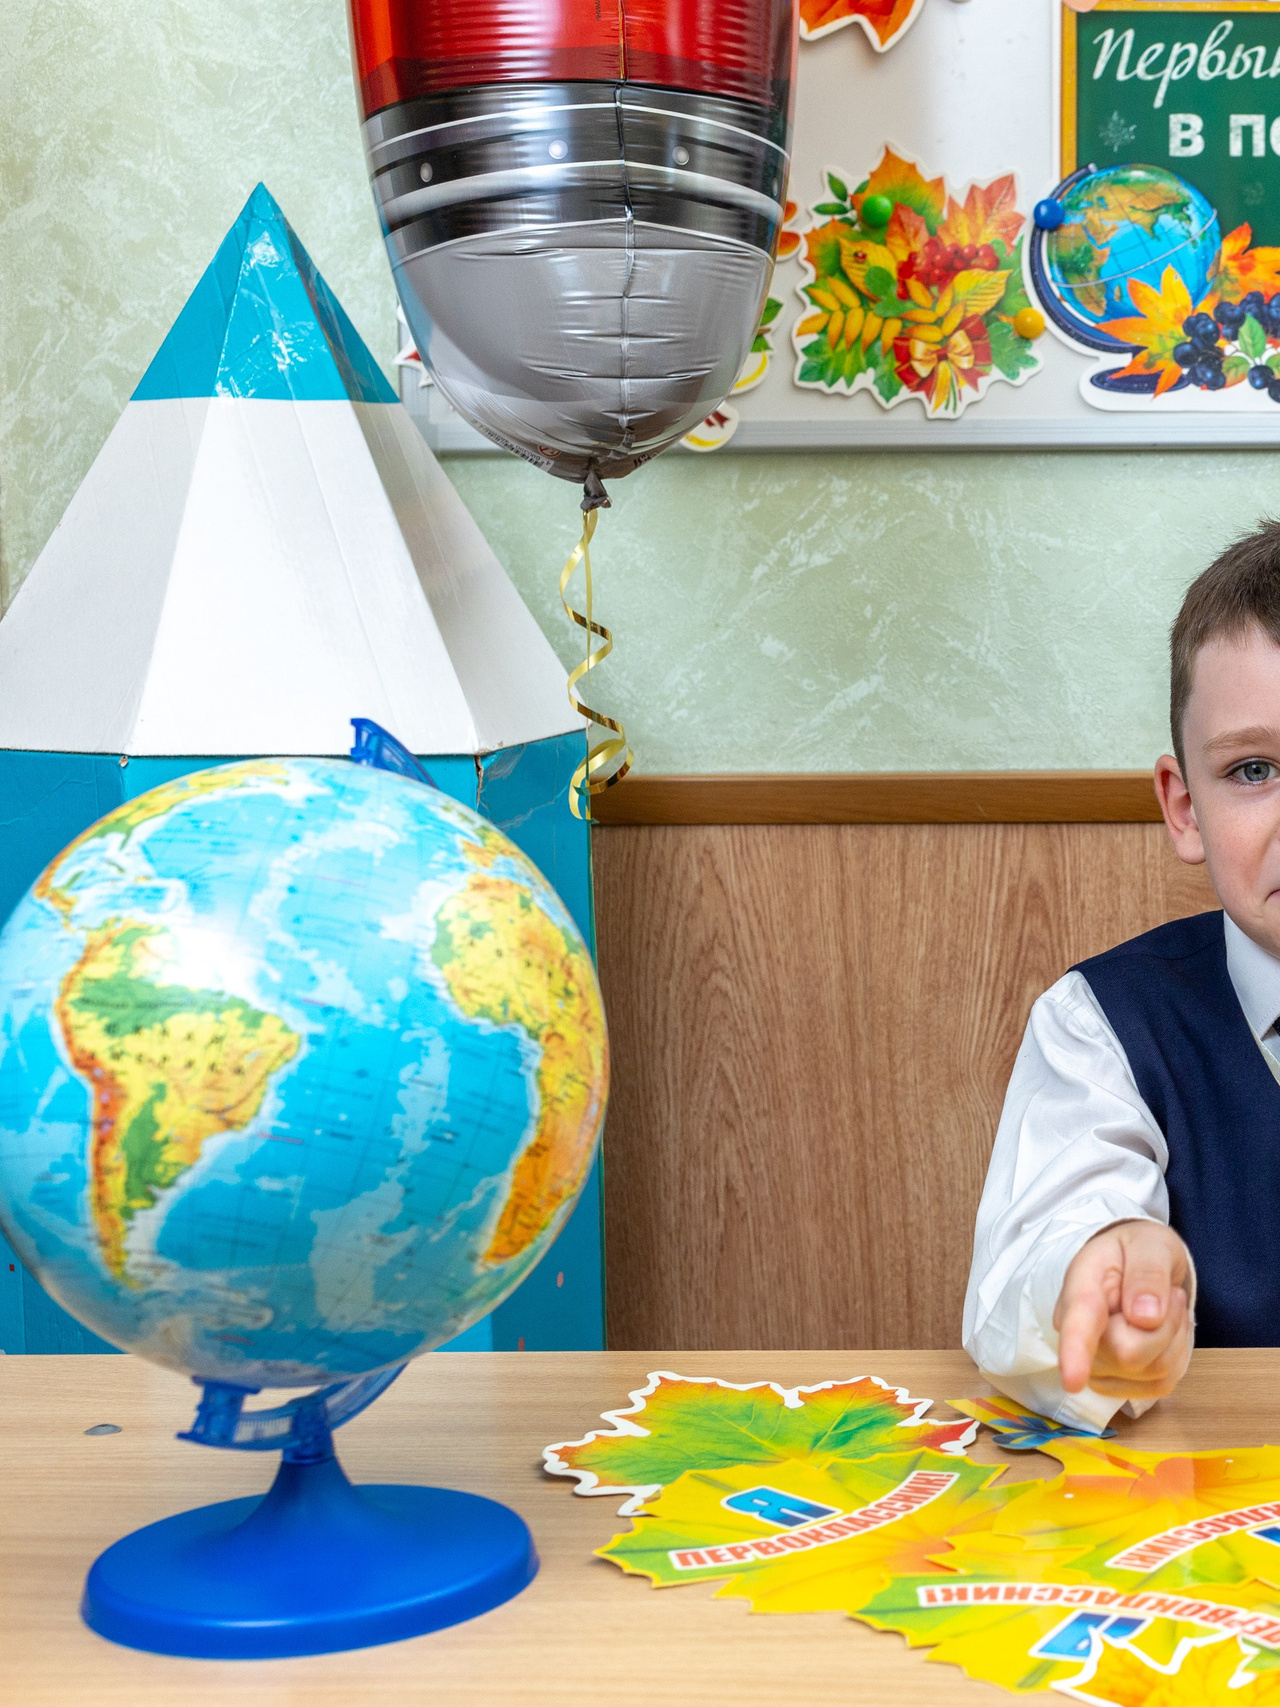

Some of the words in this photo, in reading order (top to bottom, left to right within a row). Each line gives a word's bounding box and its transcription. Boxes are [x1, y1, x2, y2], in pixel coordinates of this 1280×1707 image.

[1168, 112, 1205, 157] в
[673, 1472, 956, 1568] ПЕРВОКЛАССНИК!
[725, 1487, 839, 1528] Я
